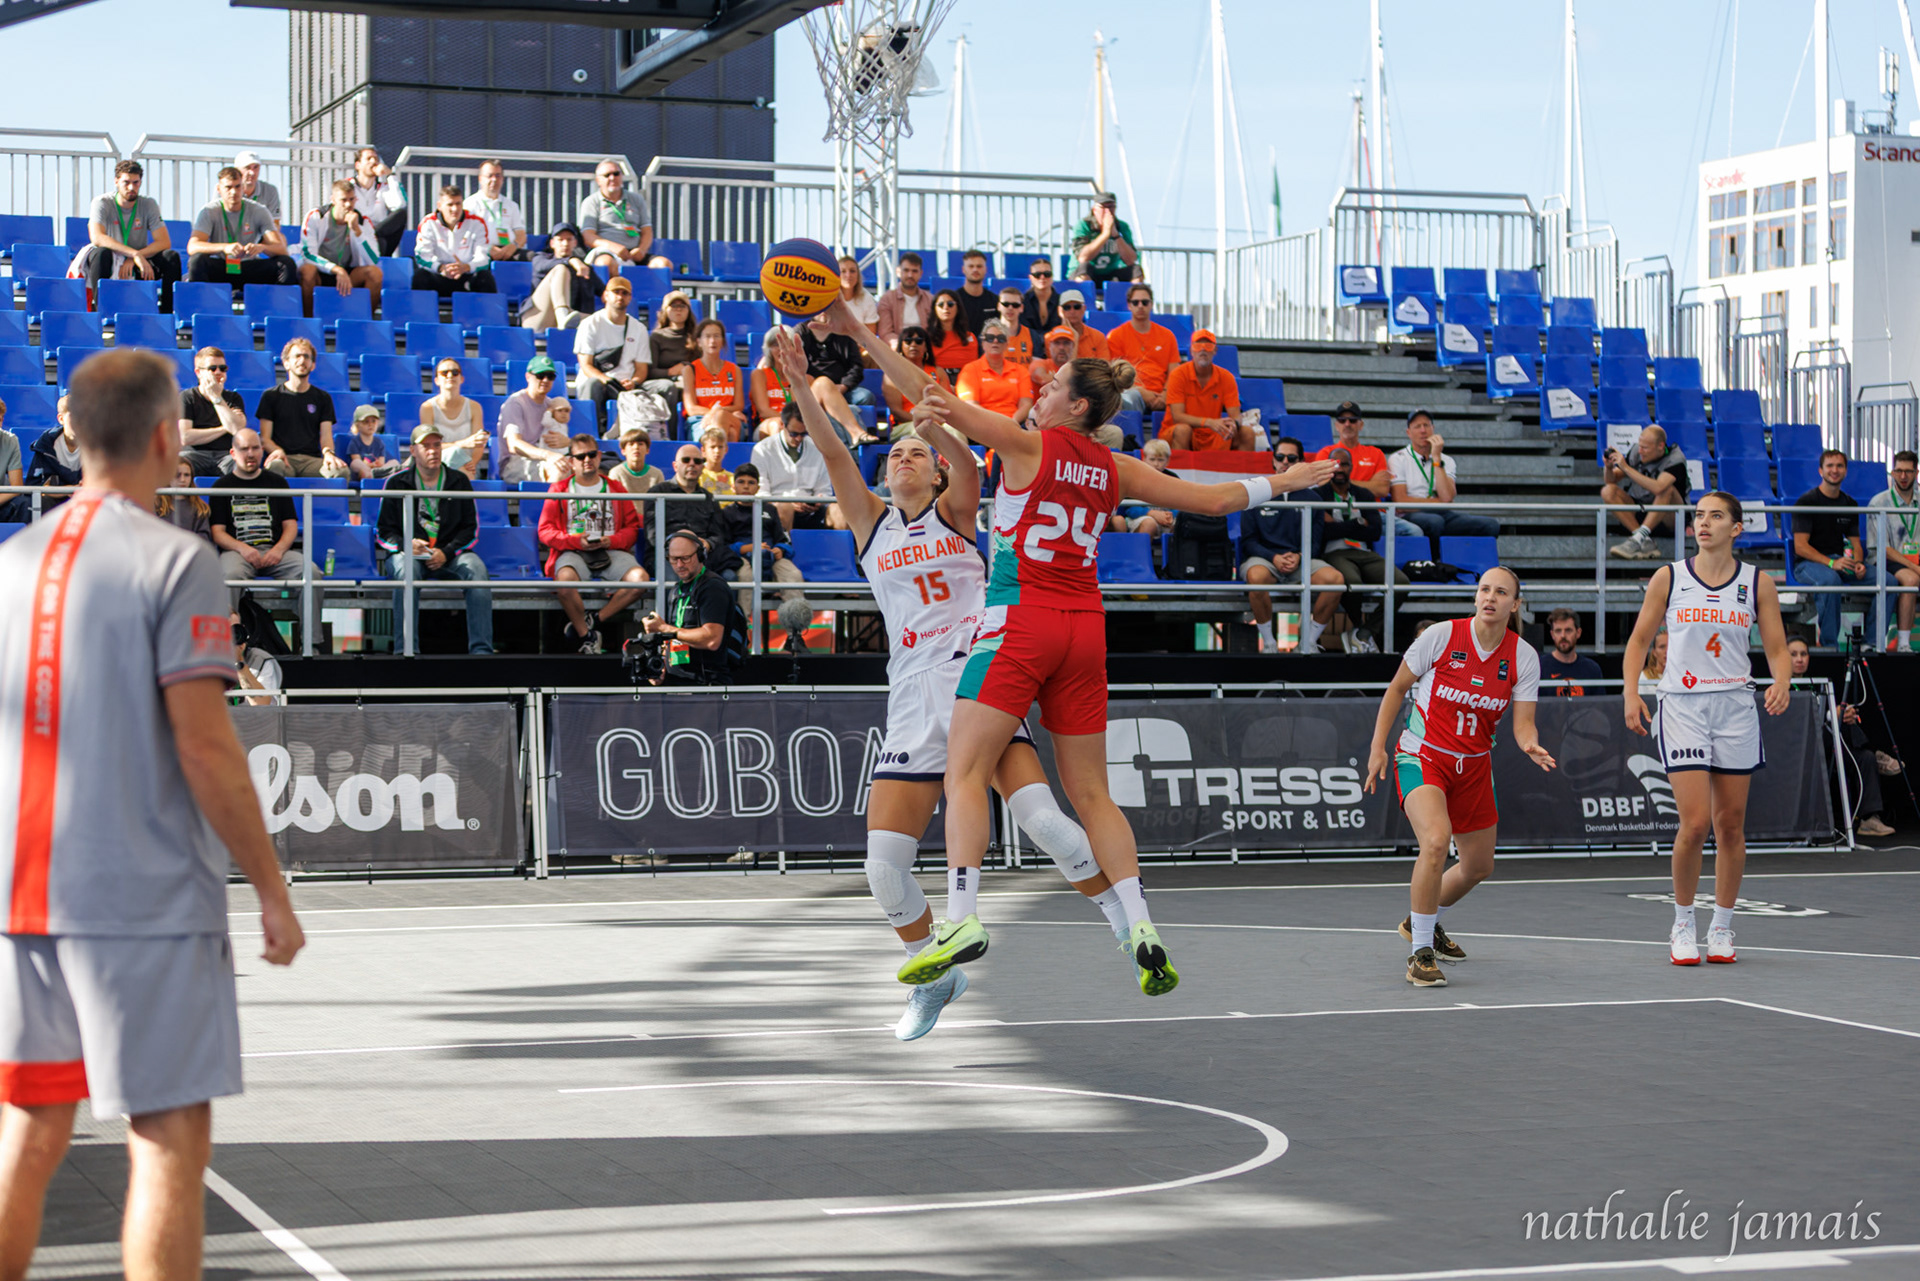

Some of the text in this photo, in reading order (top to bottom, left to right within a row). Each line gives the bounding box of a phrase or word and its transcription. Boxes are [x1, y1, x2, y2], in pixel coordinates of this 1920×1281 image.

[773, 262, 826, 286] Wilson
[696, 387, 735, 397] NEDERLAN
[1055, 459, 1108, 491] LAUFER
[1023, 501, 1108, 567] 24
[877, 535, 966, 573] NEDERLAND
[41, 583, 60, 616] ON
[913, 570, 951, 605] 15
[1677, 608, 1749, 628] NEDERLAND
[37, 620, 57, 661] THE
[1705, 633, 1722, 658] 4
[34, 665, 54, 738] COURT
[1435, 684, 1508, 711] HUNGARY
[248, 743, 465, 834] lson
[1151, 767, 1363, 806] TRESS
[1222, 809, 1366, 831] SPORT & LEG
[1582, 796, 1645, 818] DBBF
[1585, 823, 1617, 833] Denmark
[1618, 821, 1654, 832] Basketball
